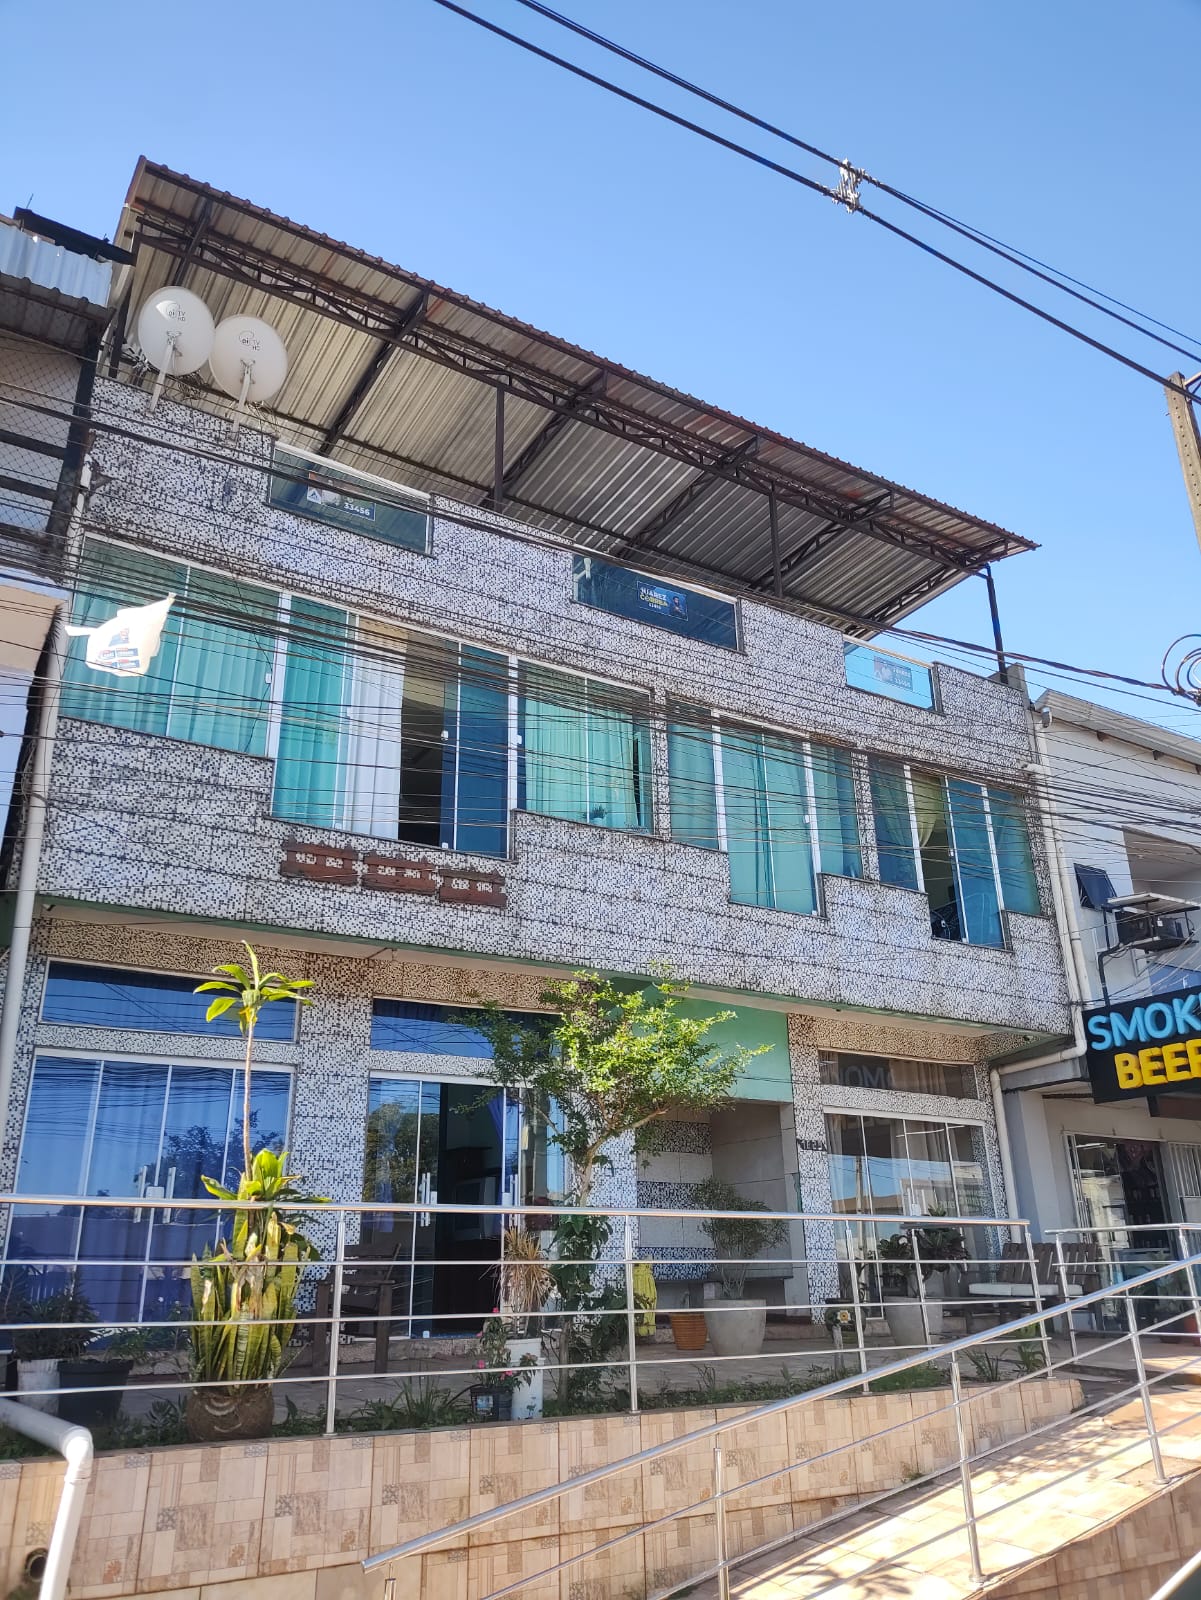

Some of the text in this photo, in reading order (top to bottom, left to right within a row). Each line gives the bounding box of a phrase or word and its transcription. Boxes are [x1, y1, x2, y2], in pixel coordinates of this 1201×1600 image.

[343, 502, 370, 516] 33456
[640, 586, 667, 601] JUAREZ
[1087, 992, 1201, 1051] SMOK
